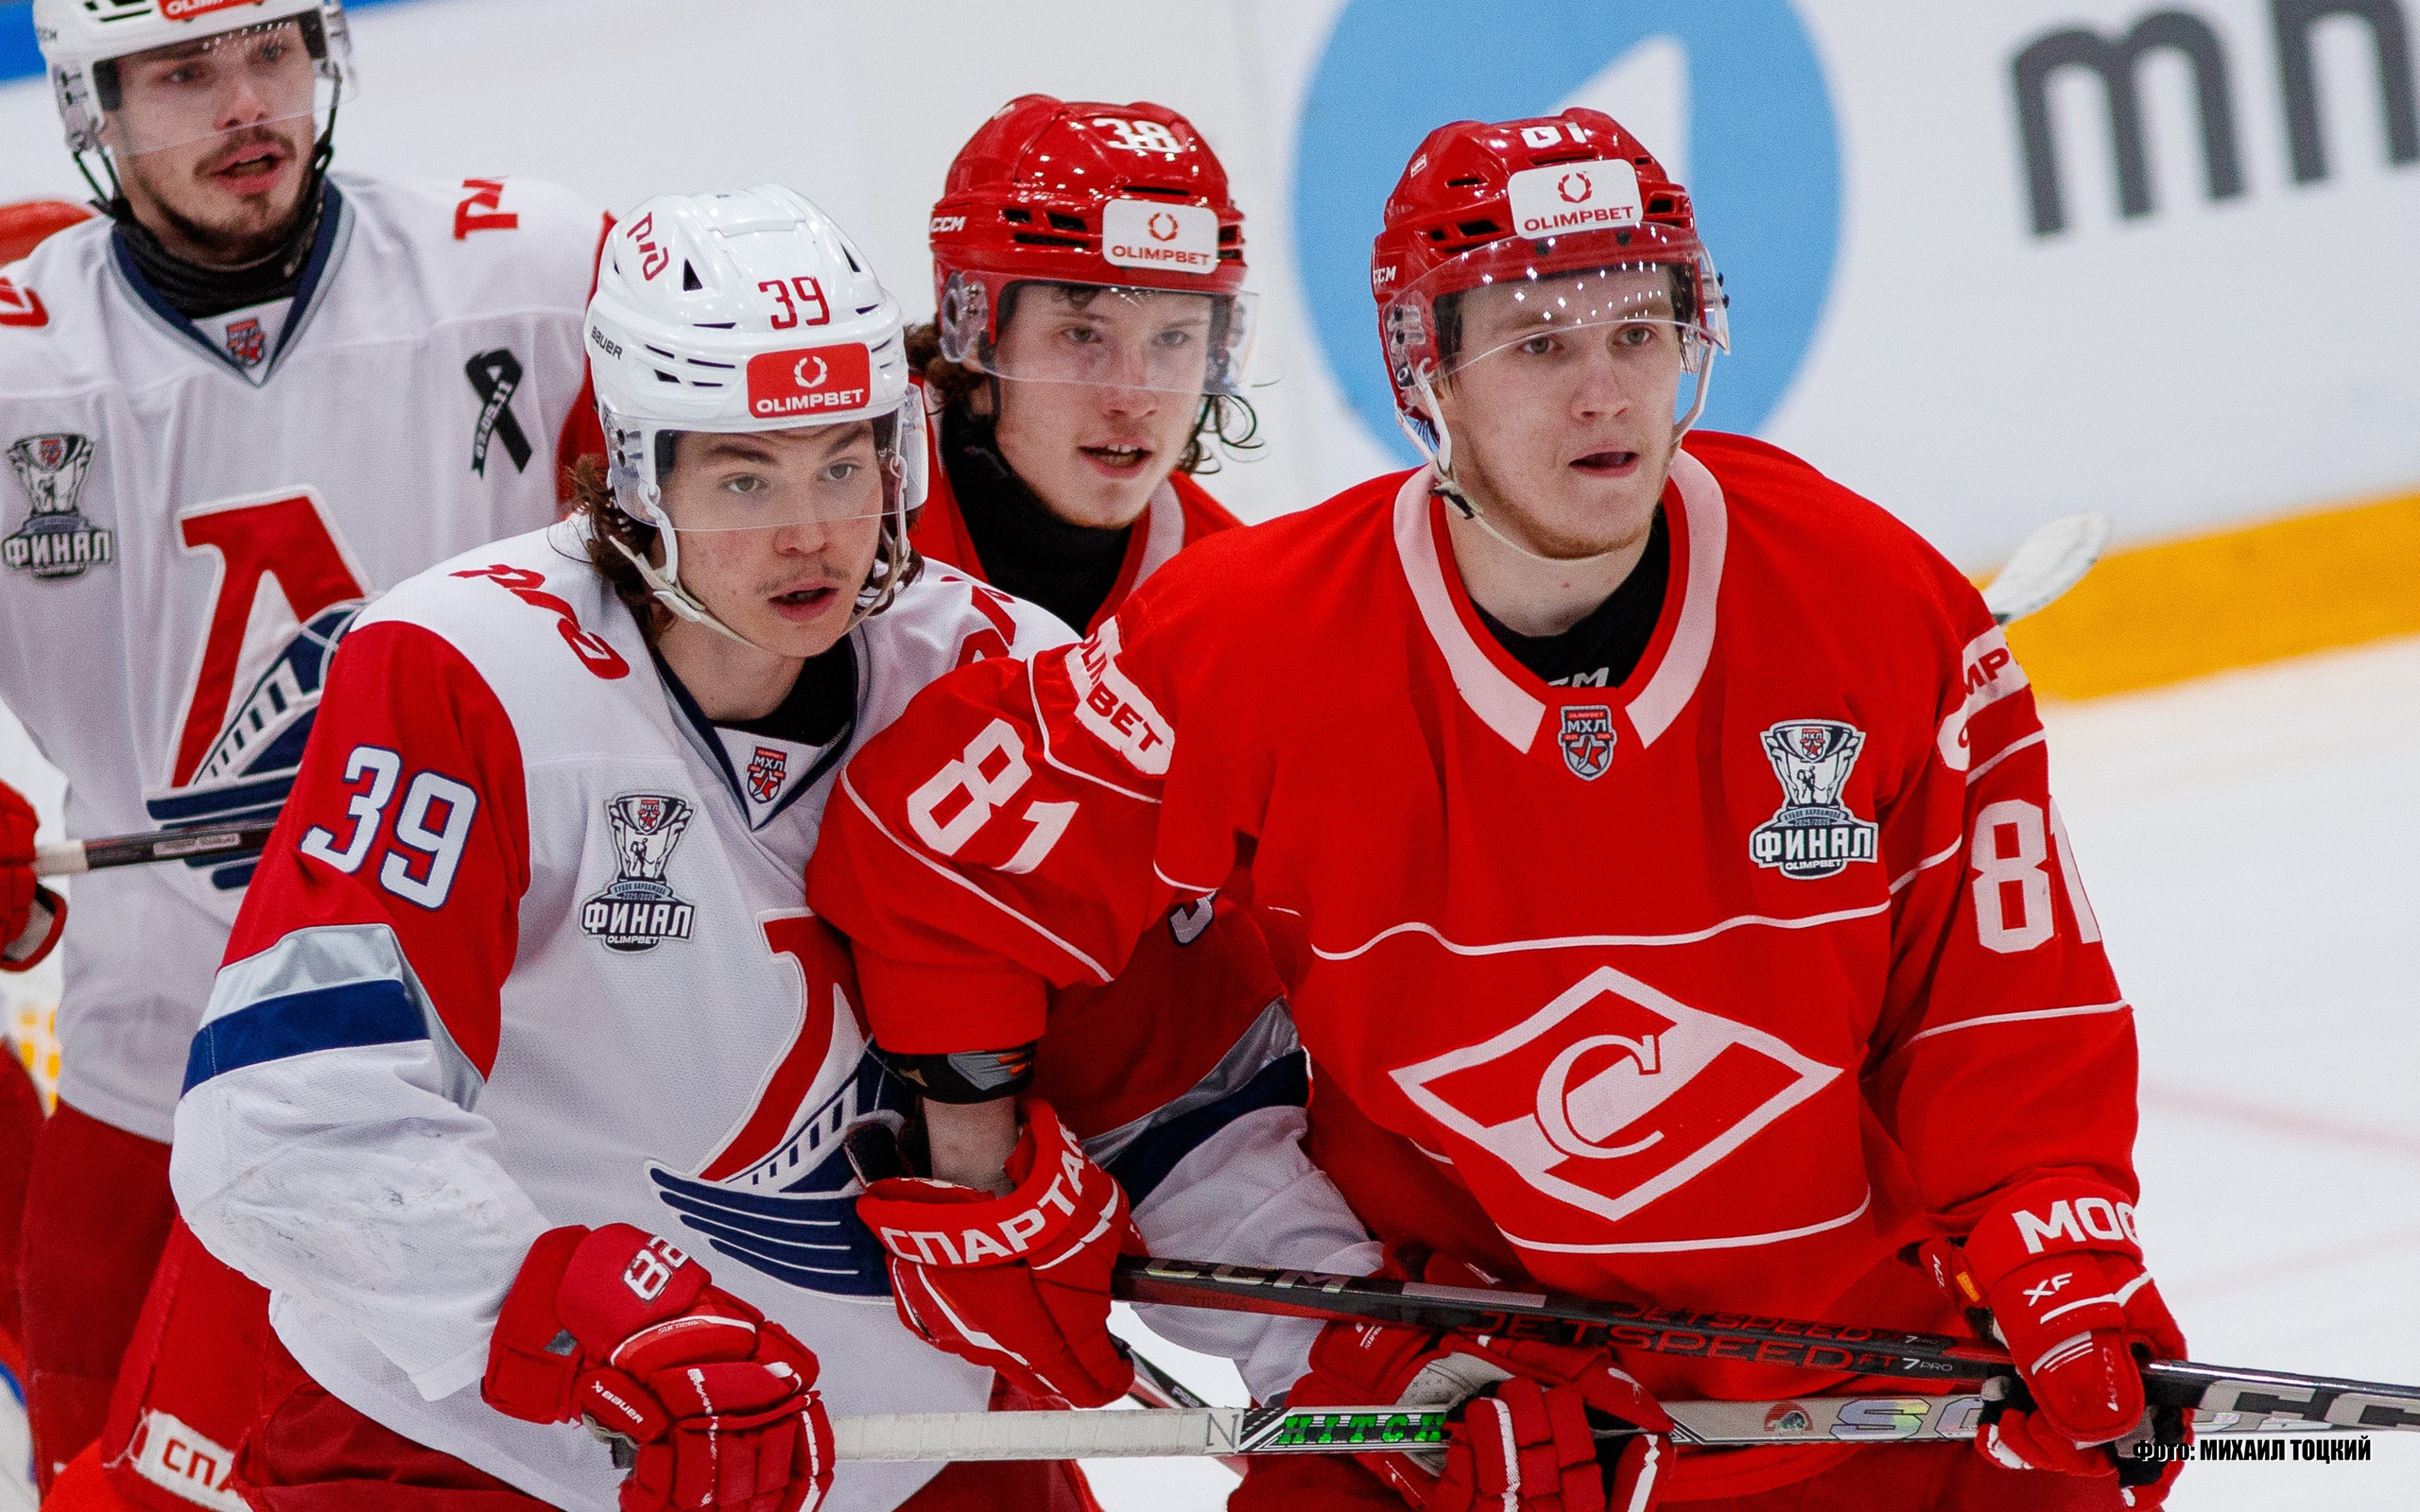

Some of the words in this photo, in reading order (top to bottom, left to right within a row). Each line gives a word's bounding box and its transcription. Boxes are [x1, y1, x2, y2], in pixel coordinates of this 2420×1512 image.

[1093, 117, 1183, 153] 38
[930, 215, 967, 232] CCM
[1523, 200, 1634, 233] OLIMPBET
[1111, 244, 1211, 266] OLIMPBET
[758, 275, 830, 331] 39
[756, 388, 864, 414] OLIMPBET
[5, 532, 111, 567] ФИНАЛ
[1567, 719, 1607, 733] МХЛ
[753, 755, 784, 771] МХЛ
[907, 717, 1080, 875] 81
[298, 744, 480, 911] 39
[1755, 827, 1872, 862] ФИНАЛ
[1786, 859, 1842, 870] OLIMPBET
[1971, 795, 2102, 954] 81
[584, 902, 692, 937] ФИНАЛ
[607, 935, 659, 944] OLIMPBET
[2022, 1272, 2073, 1307] XF
[1458, 1311, 1854, 1370] JETSPEED
[1613, 1306, 1873, 1342] JETSPEED
